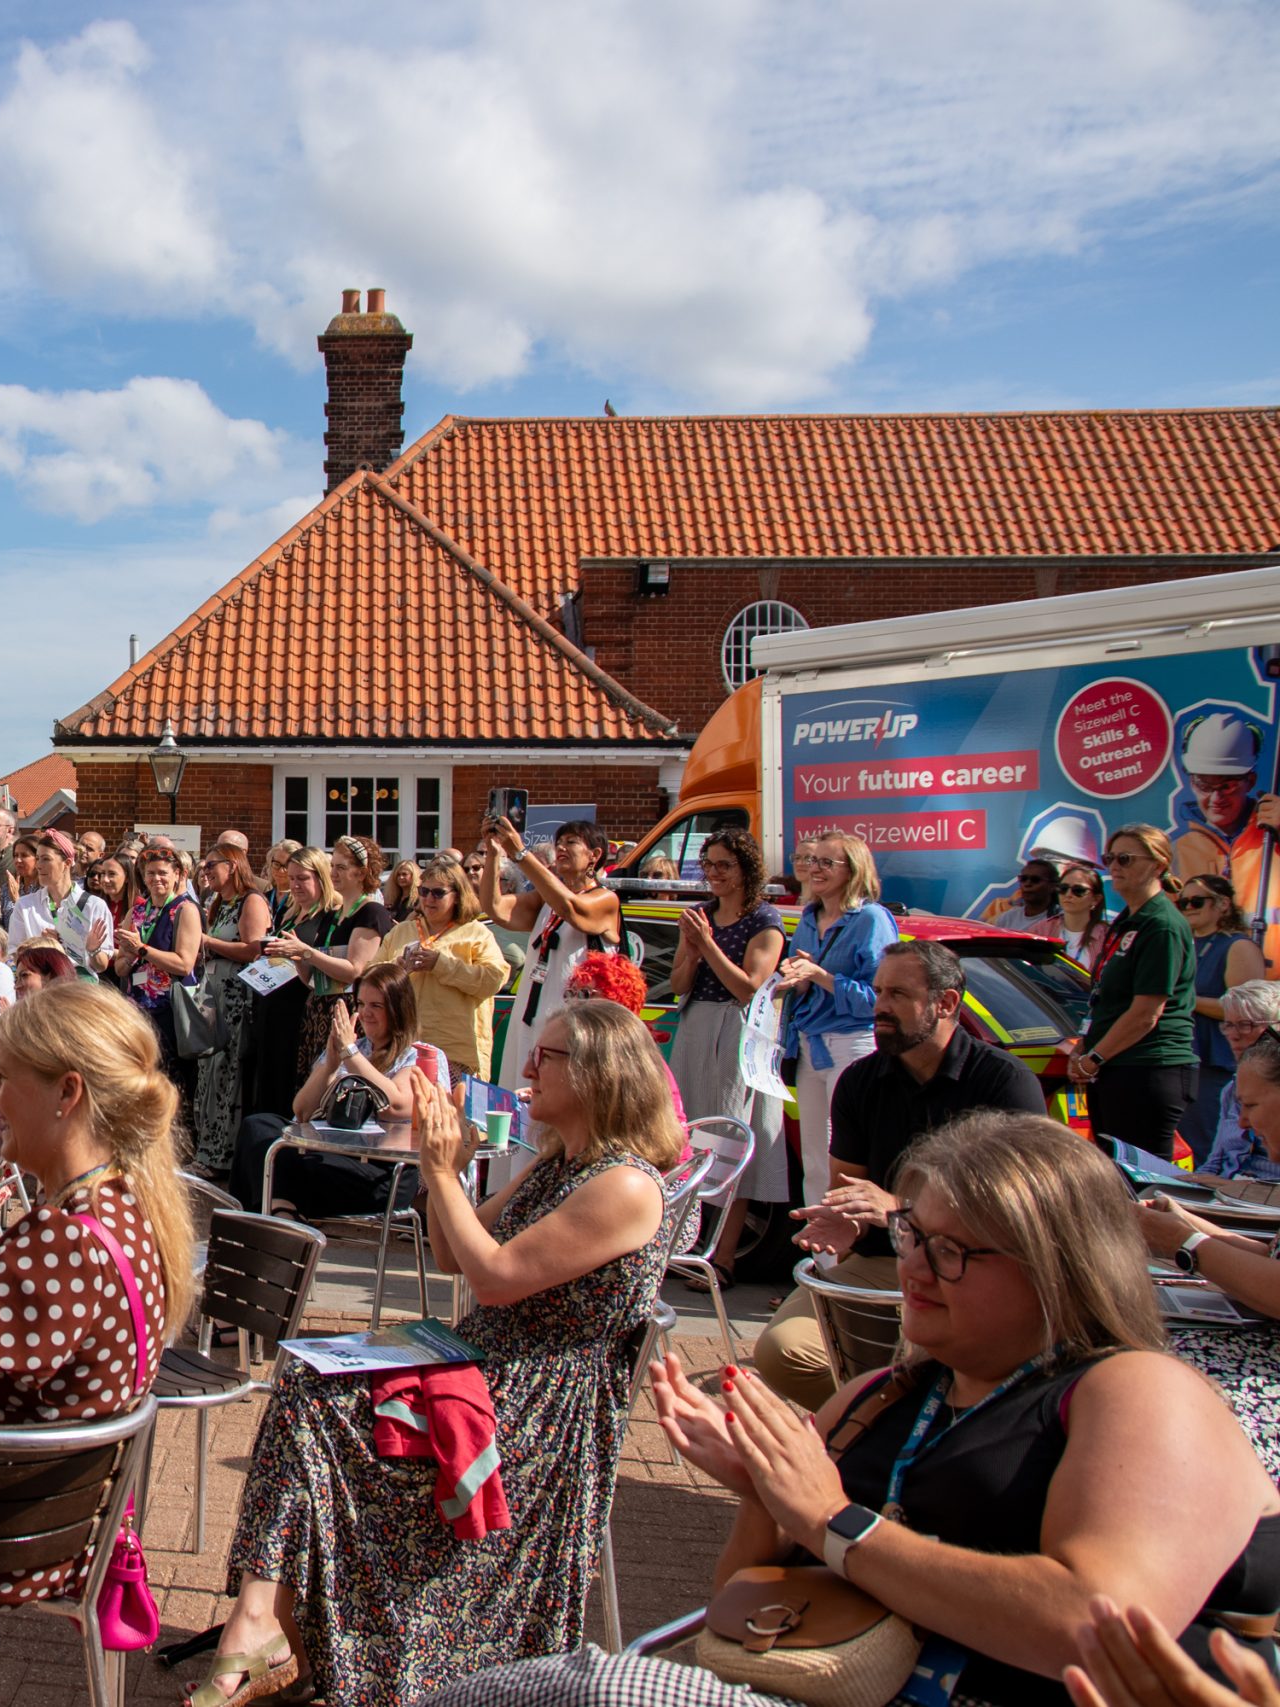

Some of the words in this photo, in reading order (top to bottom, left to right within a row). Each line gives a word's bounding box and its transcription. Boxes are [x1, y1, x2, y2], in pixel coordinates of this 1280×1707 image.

[1074, 698, 1108, 716] Meet
[1110, 691, 1133, 706] the
[1074, 707, 1127, 733] Sizewell
[1129, 704, 1141, 717] C
[1082, 729, 1124, 749] Skills
[1127, 723, 1140, 738] &
[1079, 739, 1153, 769] Outreach
[800, 773, 852, 795] Your
[858, 769, 934, 792] future
[941, 764, 1027, 788] career
[1094, 760, 1143, 784] Team!
[854, 819, 949, 845] Sizewell
[957, 818, 977, 842] C
